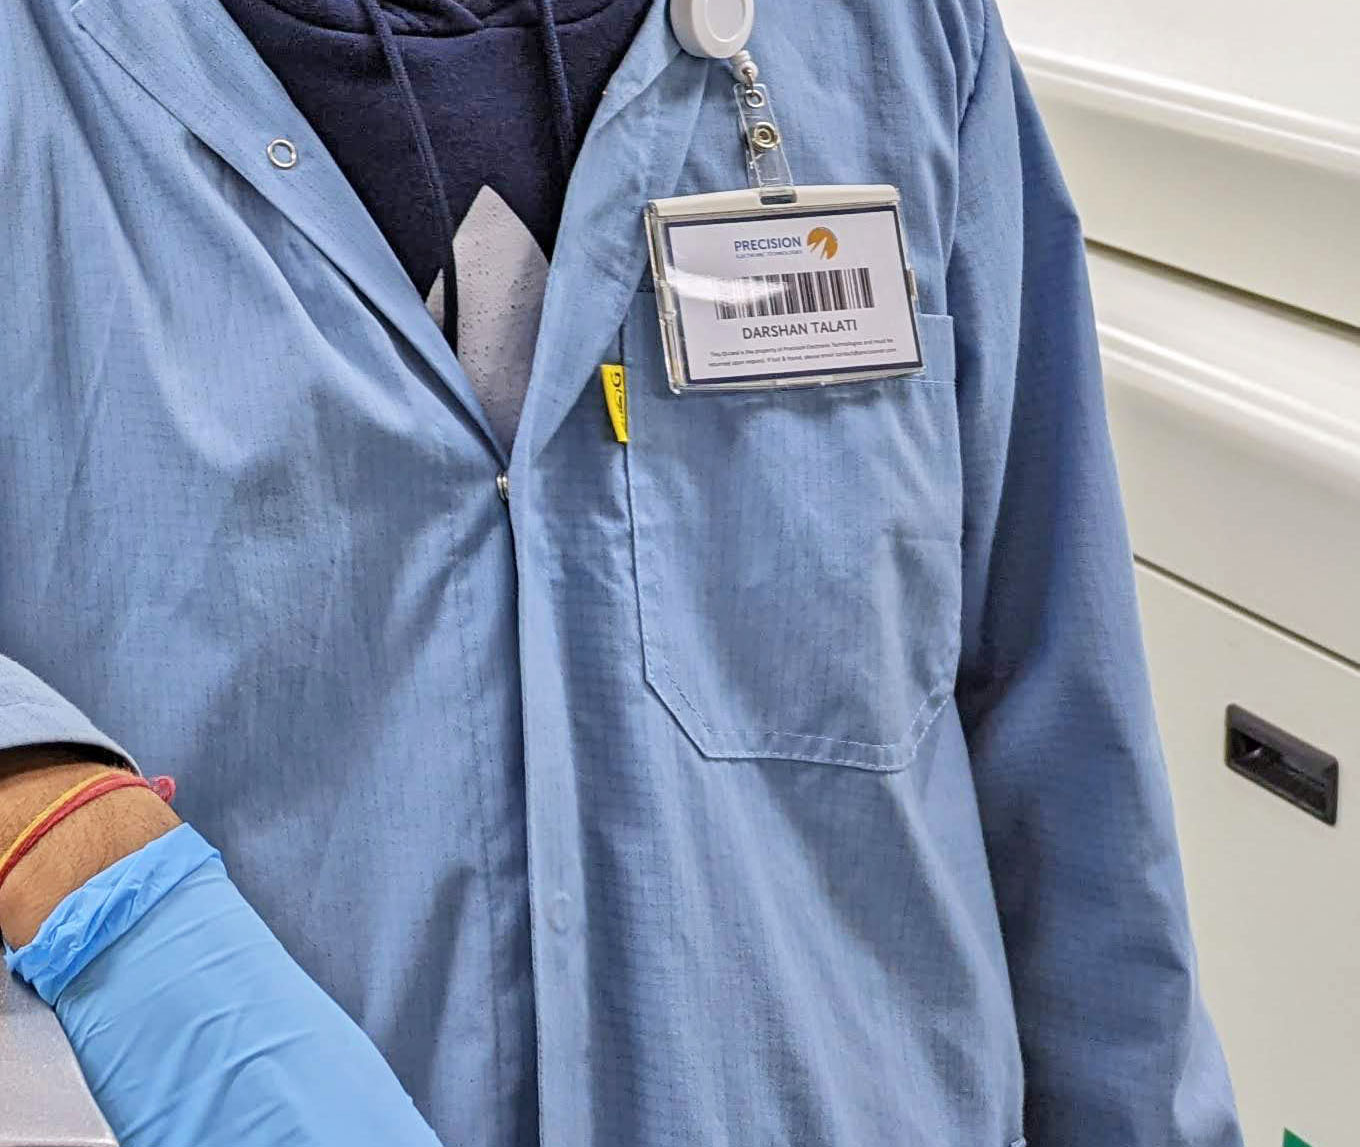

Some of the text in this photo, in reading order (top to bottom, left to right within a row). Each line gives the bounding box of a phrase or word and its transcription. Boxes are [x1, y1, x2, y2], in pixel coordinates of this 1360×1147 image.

[734, 236, 802, 252] PRECISION
[742, 319, 858, 340] DARSHAN TALATI
